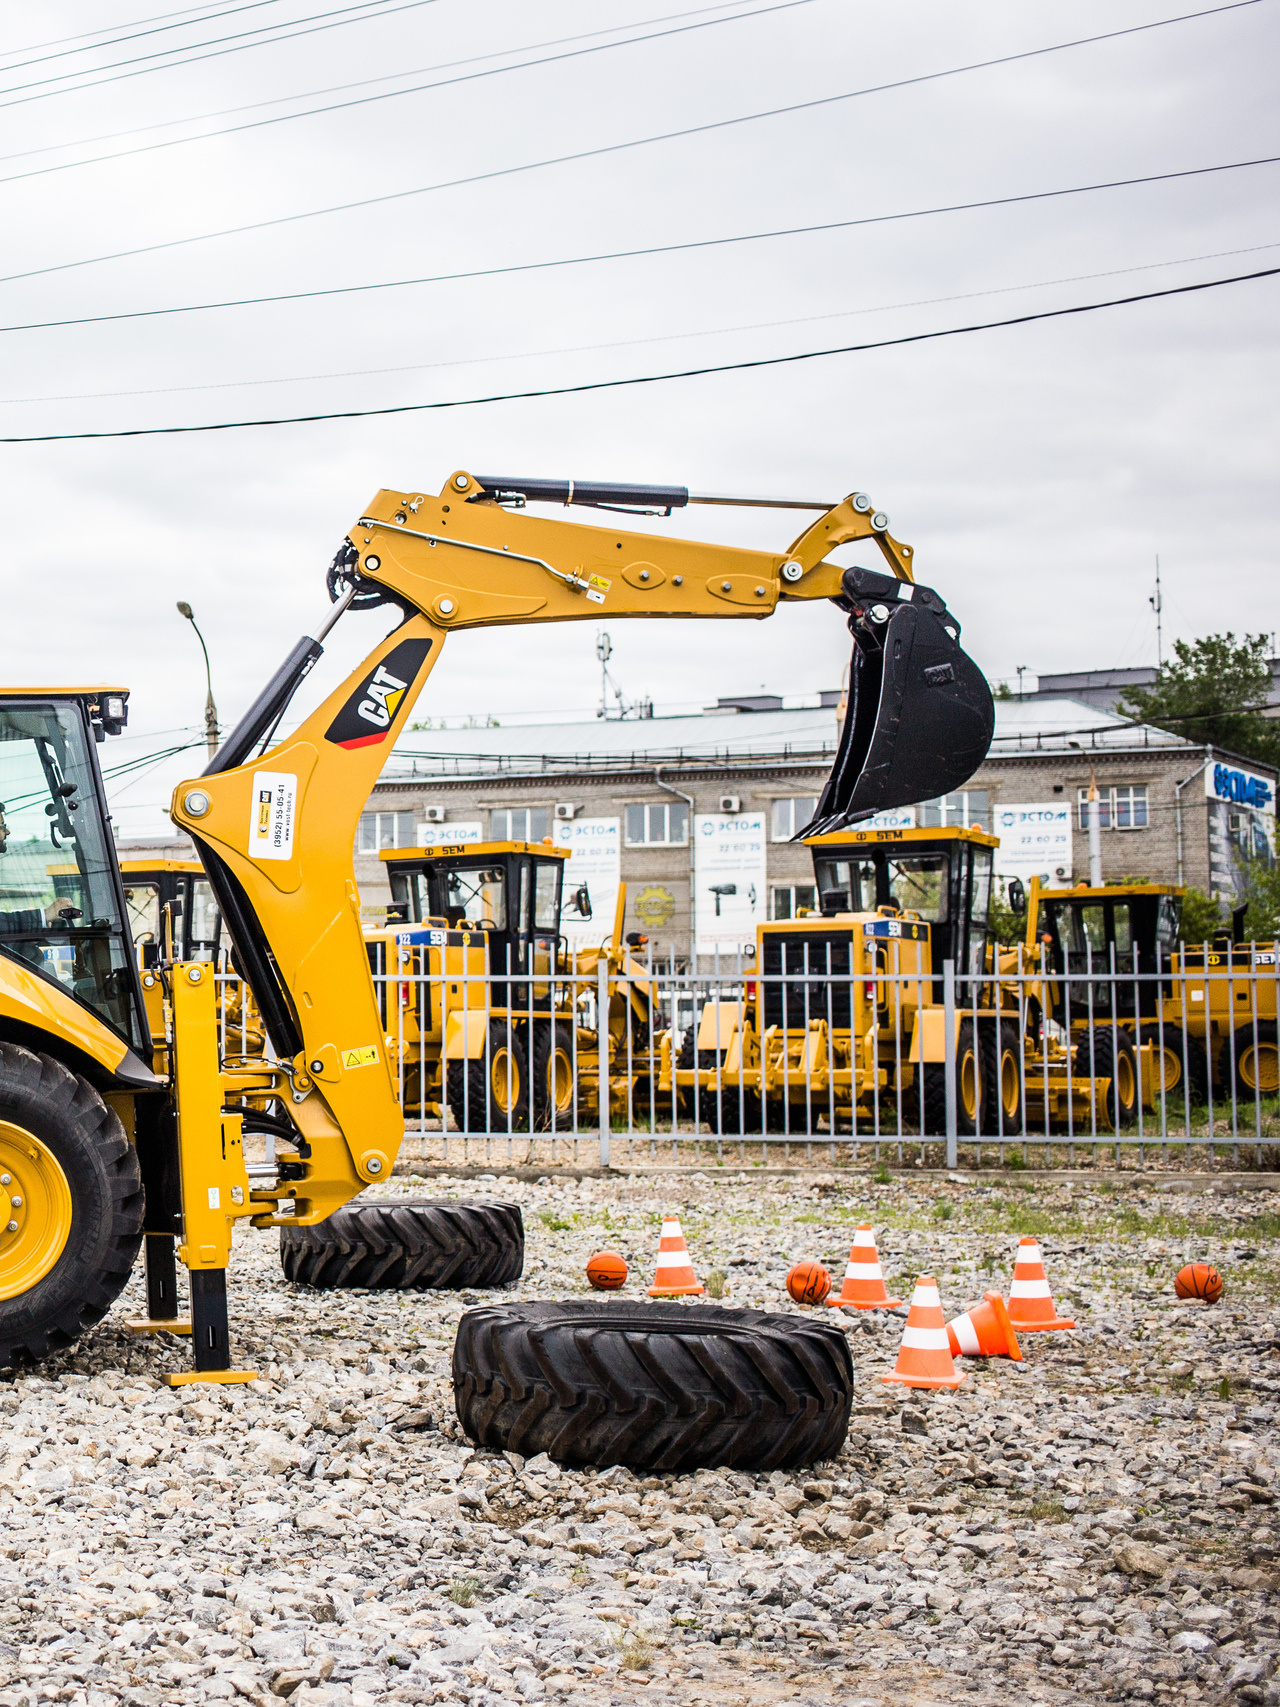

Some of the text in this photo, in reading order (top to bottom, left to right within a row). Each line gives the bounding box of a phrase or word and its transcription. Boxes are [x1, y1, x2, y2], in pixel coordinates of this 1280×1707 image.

[358, 665, 408, 727] CAT
[274, 784, 285, 847] (3952) 55-05-41
[1020, 811, 1066, 821] ЭСТОМ
[719, 821, 760, 831] ЭСТОМ
[867, 817, 911, 826] ЭСТОМ
[440, 830, 477, 839] ЭСТОМ
[576, 825, 616, 835] ЭСТОМ
[877, 831, 903, 840] SEM
[442, 845, 465, 855] SEM
[888, 921, 902, 937] SEM
[399, 931, 448, 945] 922 SEM
